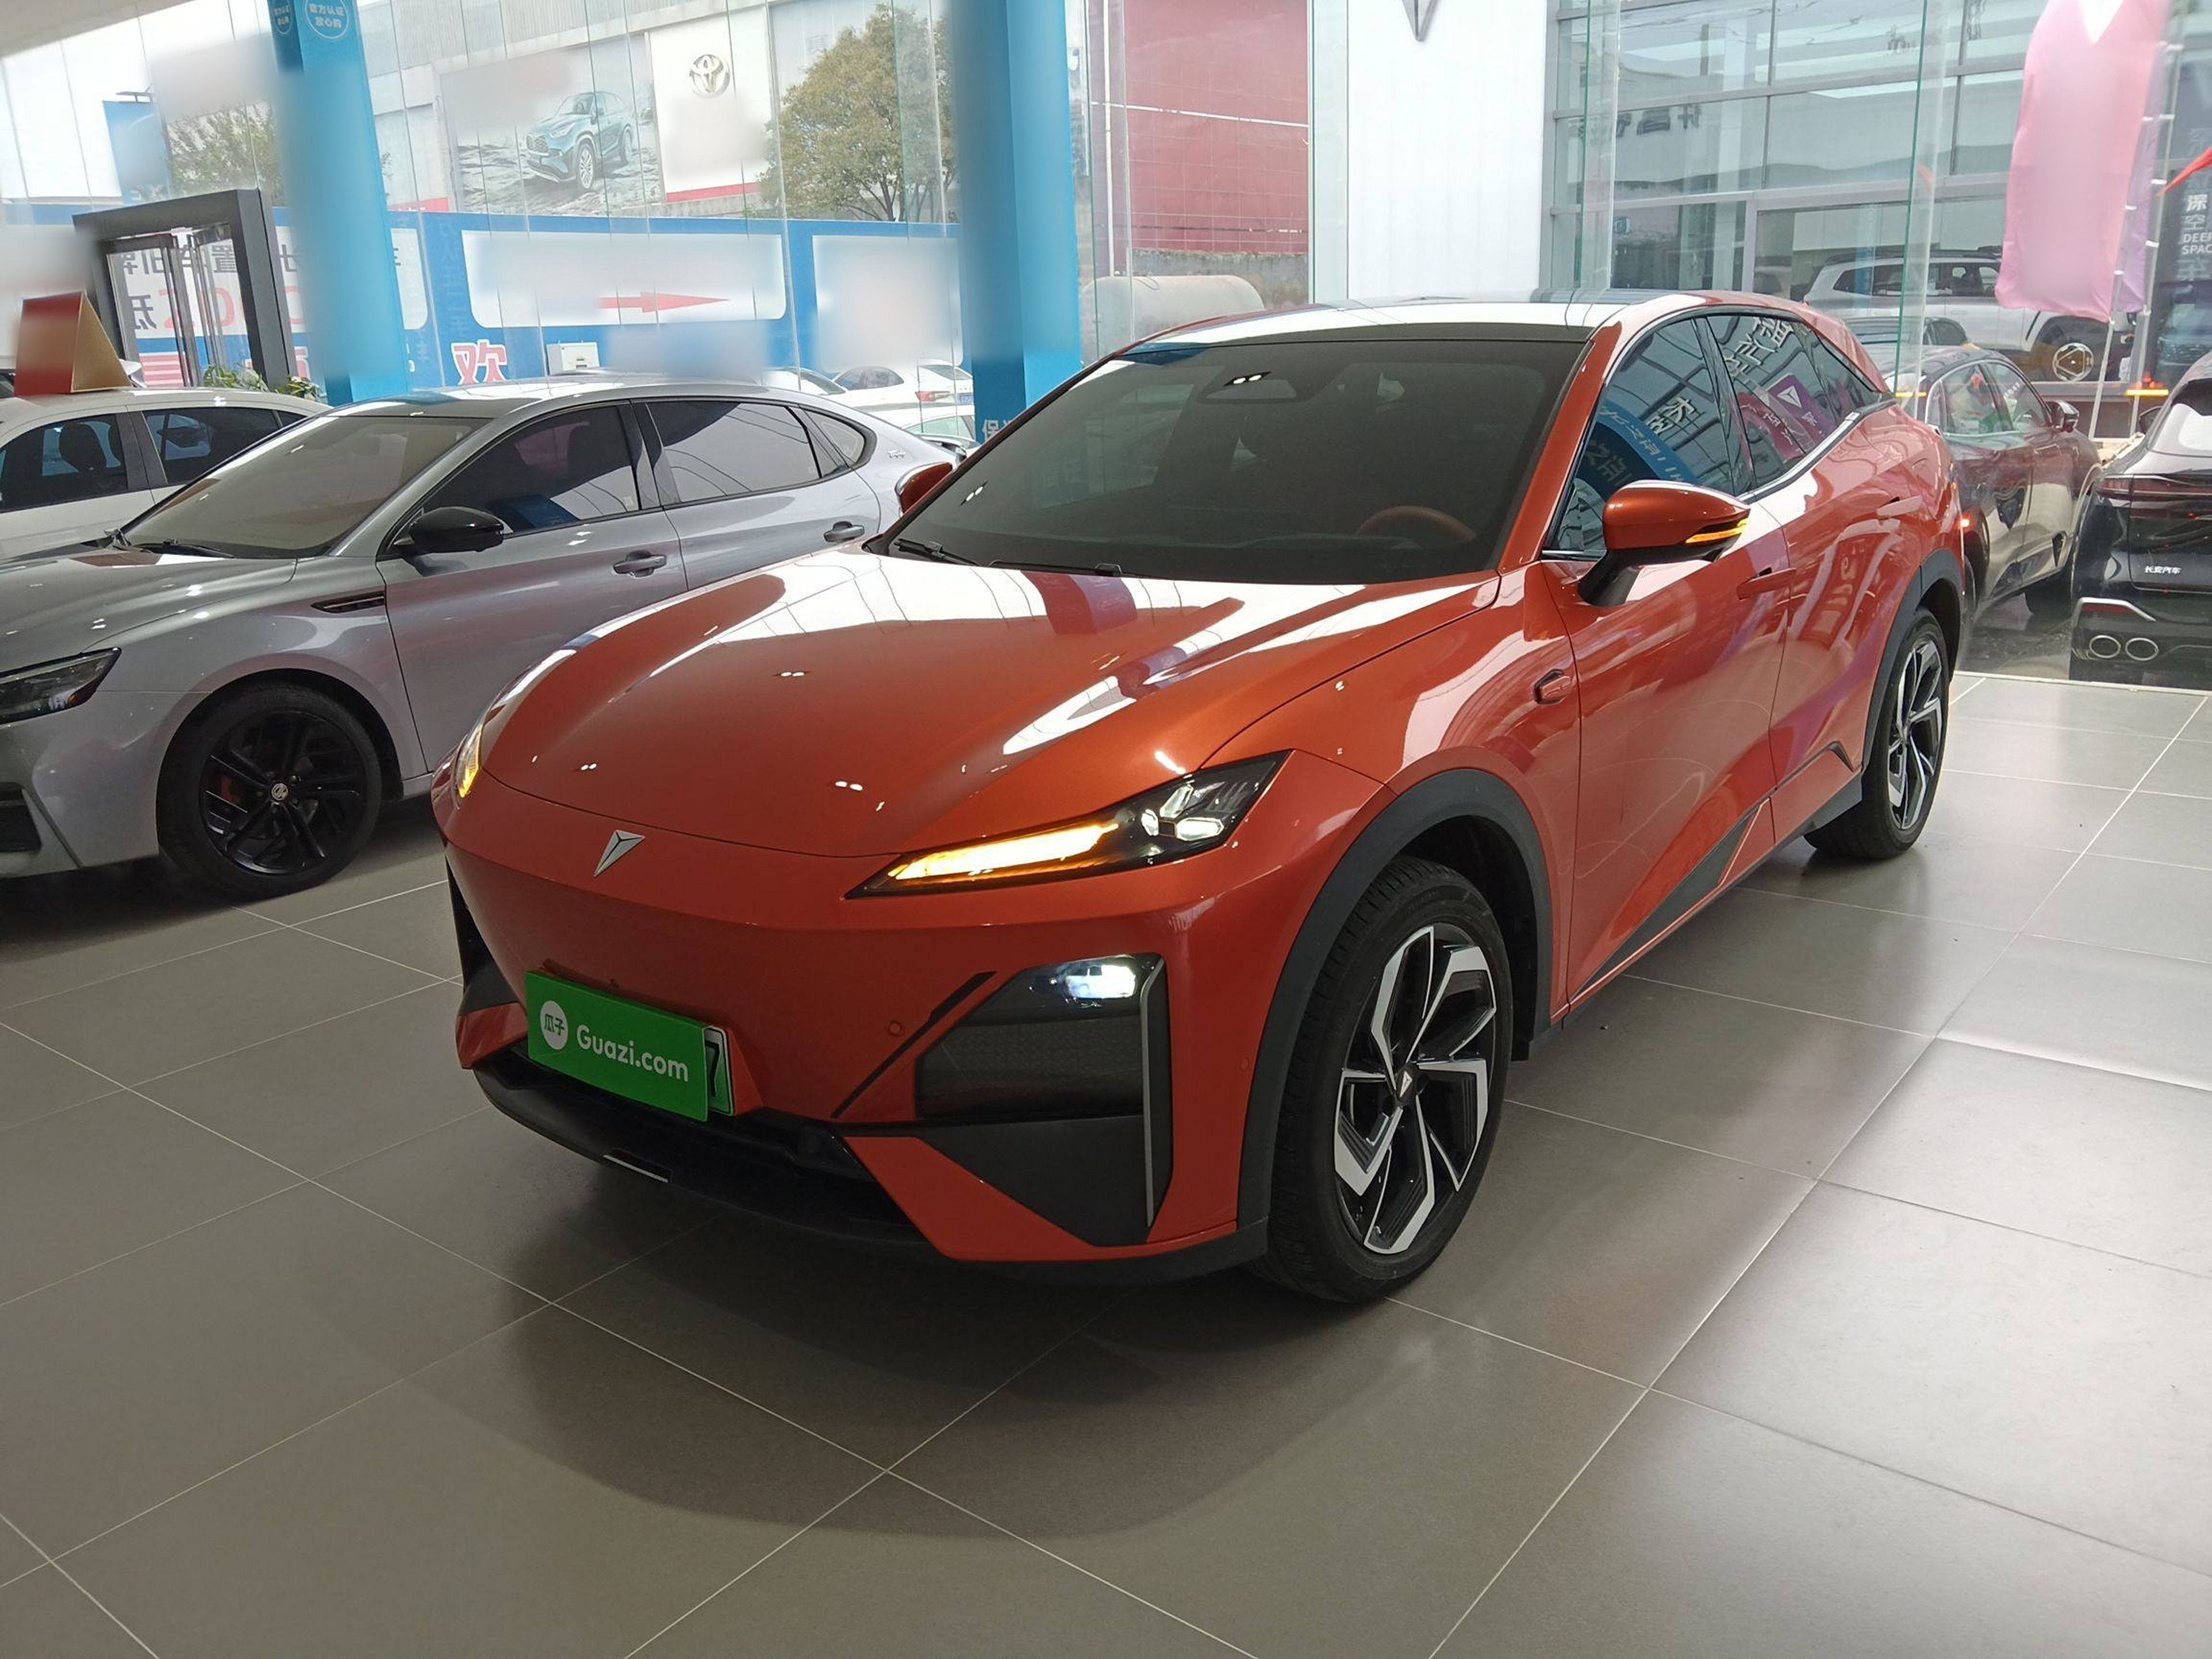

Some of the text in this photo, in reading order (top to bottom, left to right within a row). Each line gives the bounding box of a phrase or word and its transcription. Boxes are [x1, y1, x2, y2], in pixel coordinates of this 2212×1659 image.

[309, 3, 343, 16] 官方认证
[451, 339, 507, 385] 欢
[2145, 566, 2181, 574] 长安汽车
[544, 1013, 688, 1082] 瓜子 Guazi.com
